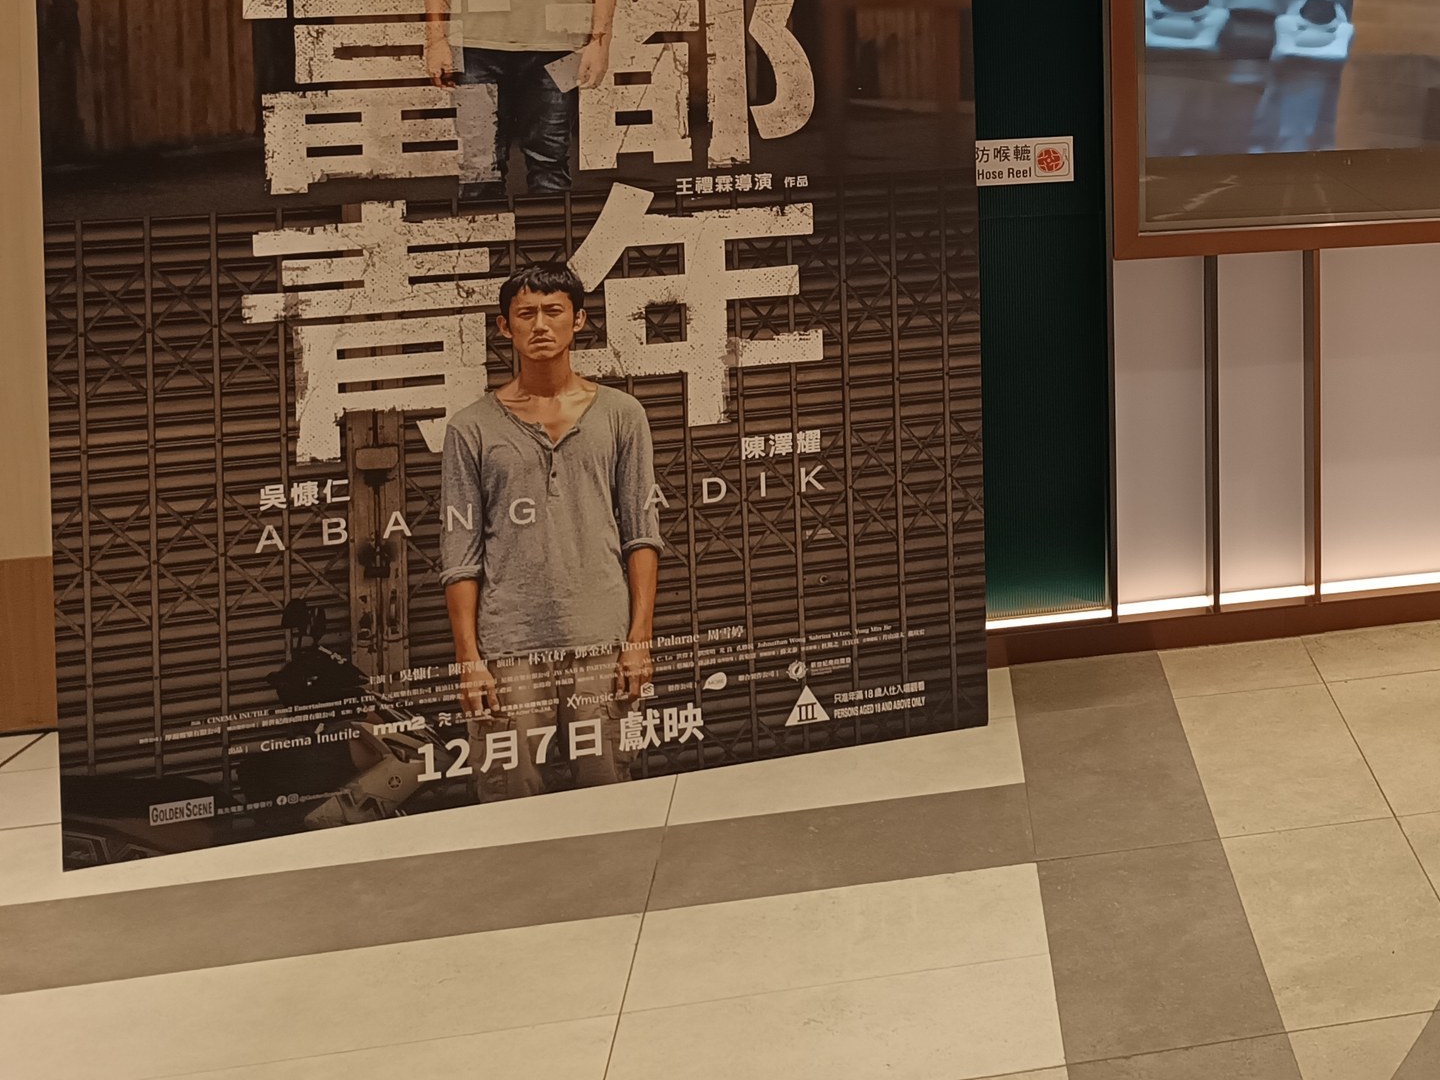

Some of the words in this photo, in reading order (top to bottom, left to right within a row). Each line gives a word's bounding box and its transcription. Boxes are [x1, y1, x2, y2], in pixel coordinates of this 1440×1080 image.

[784, 176, 809, 188] 作品
[977, 169, 1004, 181] Hose
[1007, 166, 1032, 179] Reel
[241, 181, 824, 464] 青年
[255, 498, 538, 555] ABANG
[643, 465, 826, 512] ADIK
[621, 640, 653, 653] Bront
[657, 634, 700, 648] Palarae
[834, 706, 859, 719] PERSONS
[860, 704, 874, 716] AGED
[911, 696, 926, 708] ONLY
[373, 716, 426, 736] mm2
[260, 734, 312, 753] Cinema
[317, 727, 361, 745] Inutile
[417, 718, 602, 782] 12月7日
[619, 701, 705, 752] 獻映
